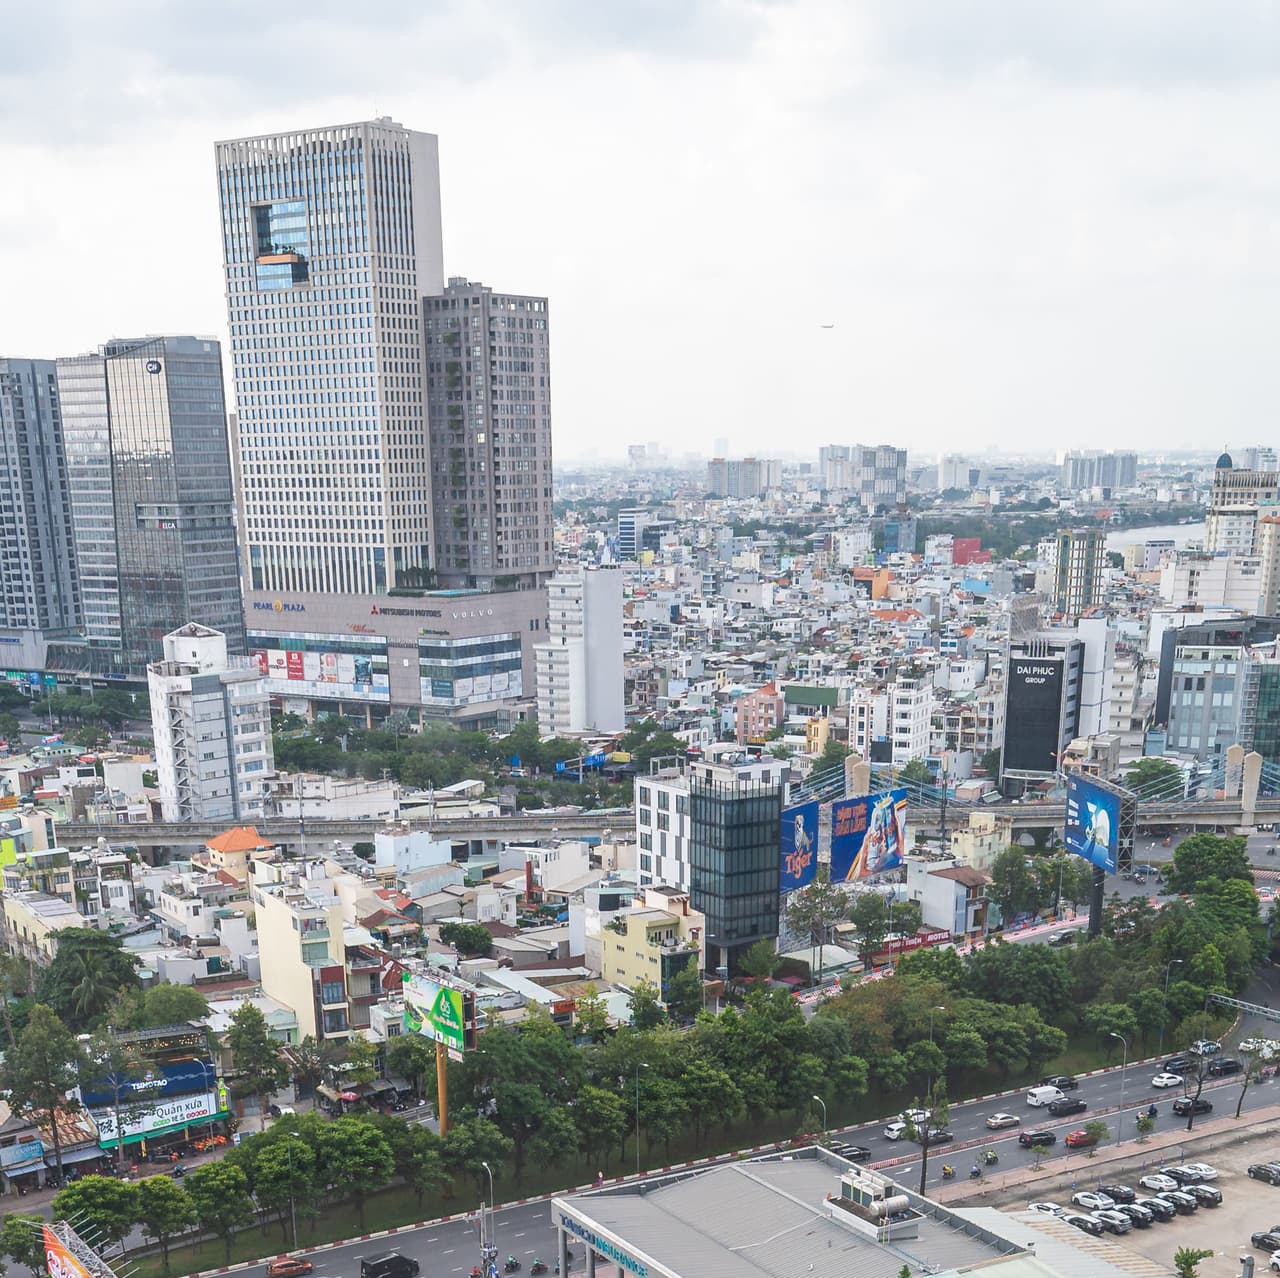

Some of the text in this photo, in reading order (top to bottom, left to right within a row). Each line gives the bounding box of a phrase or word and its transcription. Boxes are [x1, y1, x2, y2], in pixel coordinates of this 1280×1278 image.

[254, 602, 274, 610] PEARL
[380, 607, 442, 617] MITSUBISHI MOTORS
[453, 609, 493, 619] VOLVO
[785, 850, 812, 878] Tiger
[927, 932, 949, 942] MOTUL
[156, 1103, 183, 1119] Quán
[185, 1099, 202, 1111] xưa
